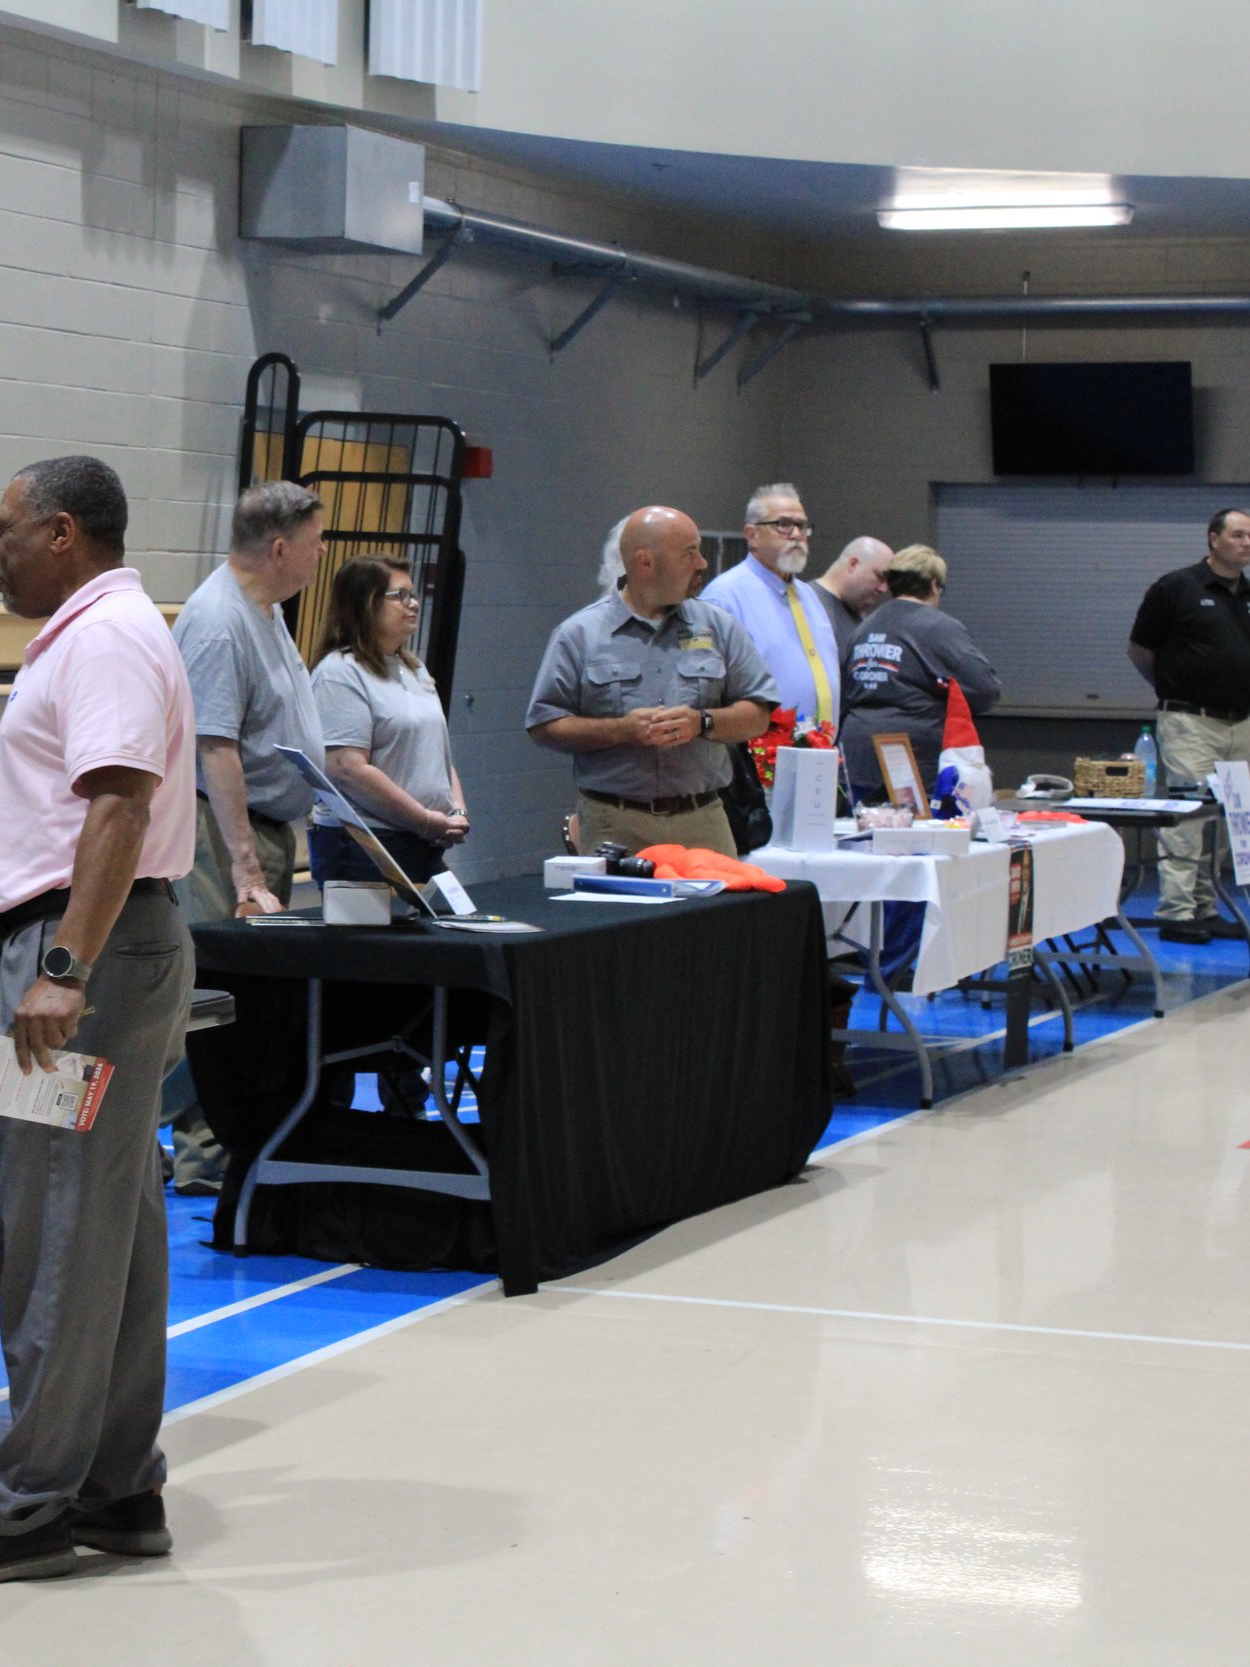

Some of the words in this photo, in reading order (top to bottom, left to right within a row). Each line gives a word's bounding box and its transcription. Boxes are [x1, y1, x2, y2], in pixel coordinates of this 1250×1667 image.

[853, 643, 903, 662] THROWER
[93, 1063, 104, 1079] 2026
[90, 1081, 99, 1090] 19,
[85, 1092, 95, 1108] MAY
[79, 1107, 89, 1126] VOTE:
